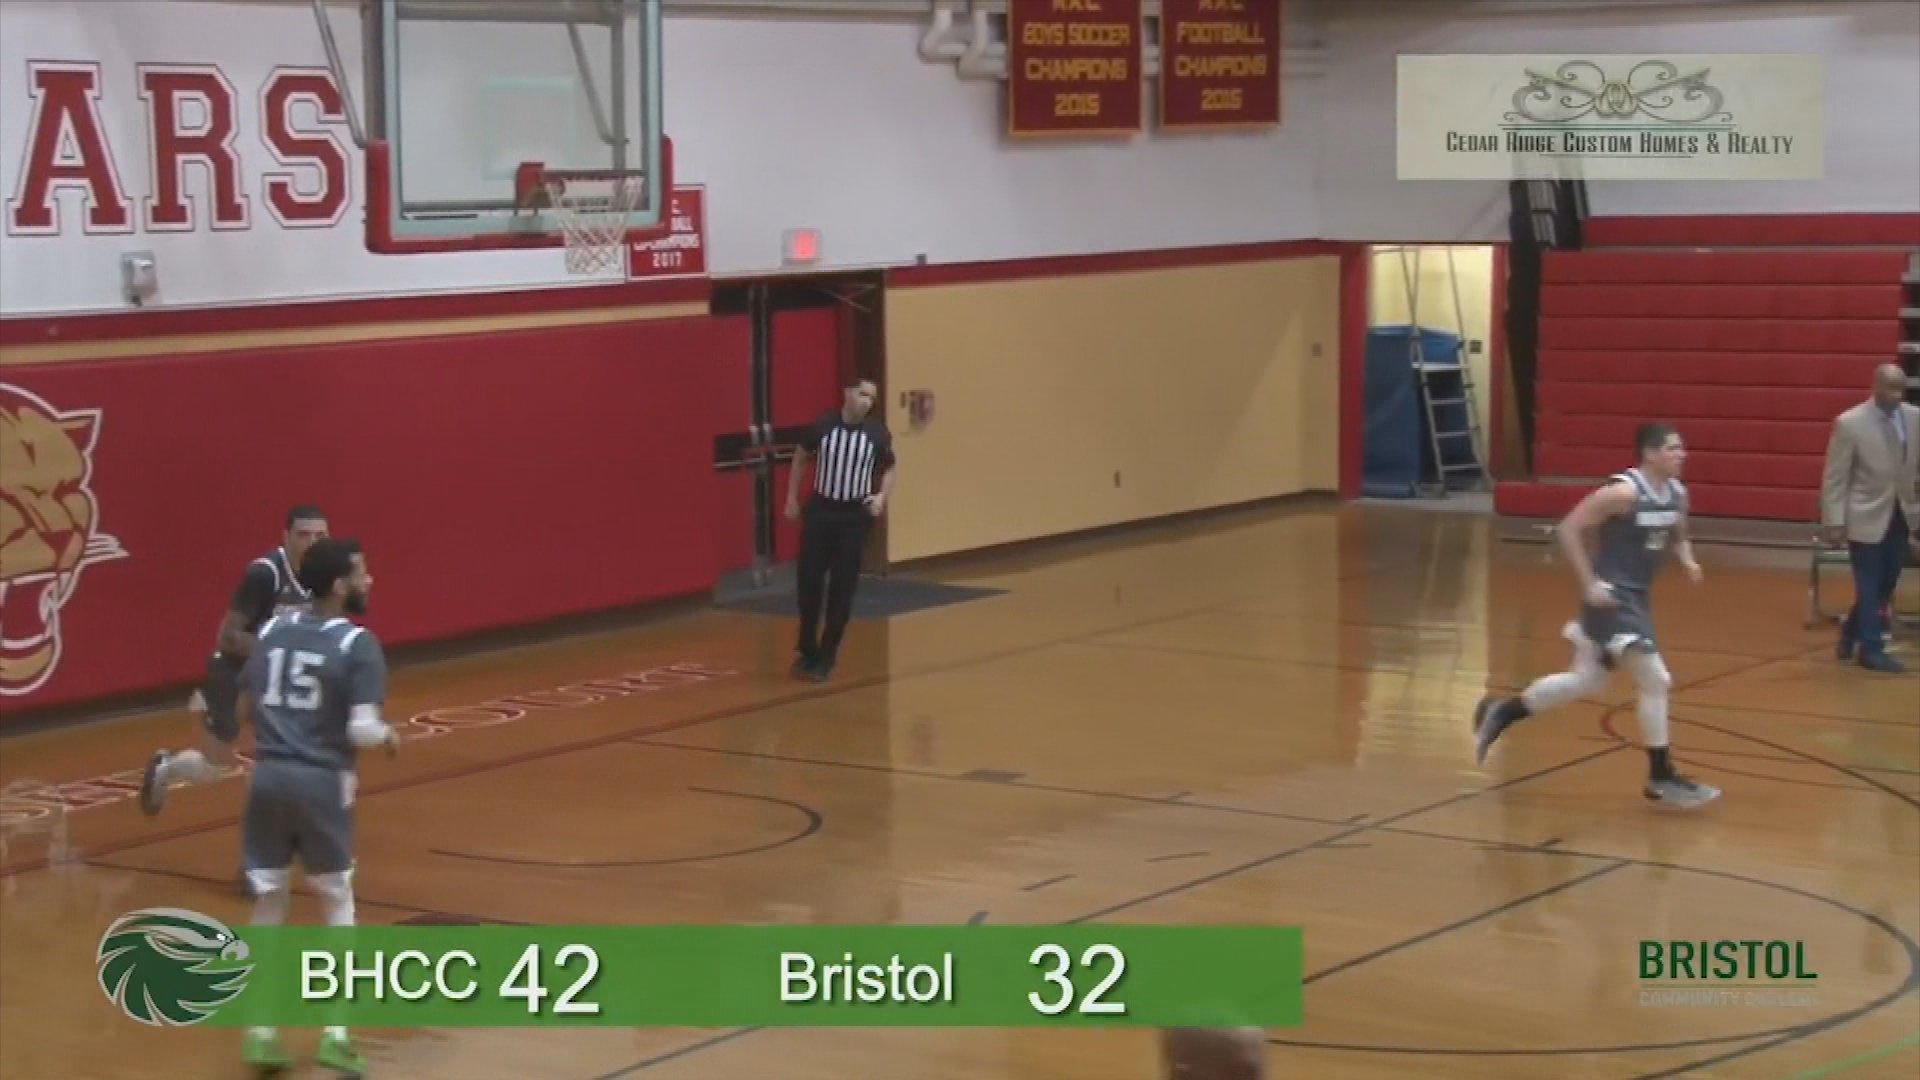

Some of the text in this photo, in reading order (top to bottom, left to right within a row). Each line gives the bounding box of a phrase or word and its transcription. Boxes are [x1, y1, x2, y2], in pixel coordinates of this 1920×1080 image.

[1022, 22, 1130, 46] BOYS SOCCER
[1176, 21, 1265, 44] FOOTBALL
[1025, 58, 1127, 81] CHAMPIONS
[1174, 54, 1267, 77] CHAMPIONS
[1054, 93, 1100, 116] 2015
[652, 252, 683, 268] 2017
[261, 647, 328, 710] 15
